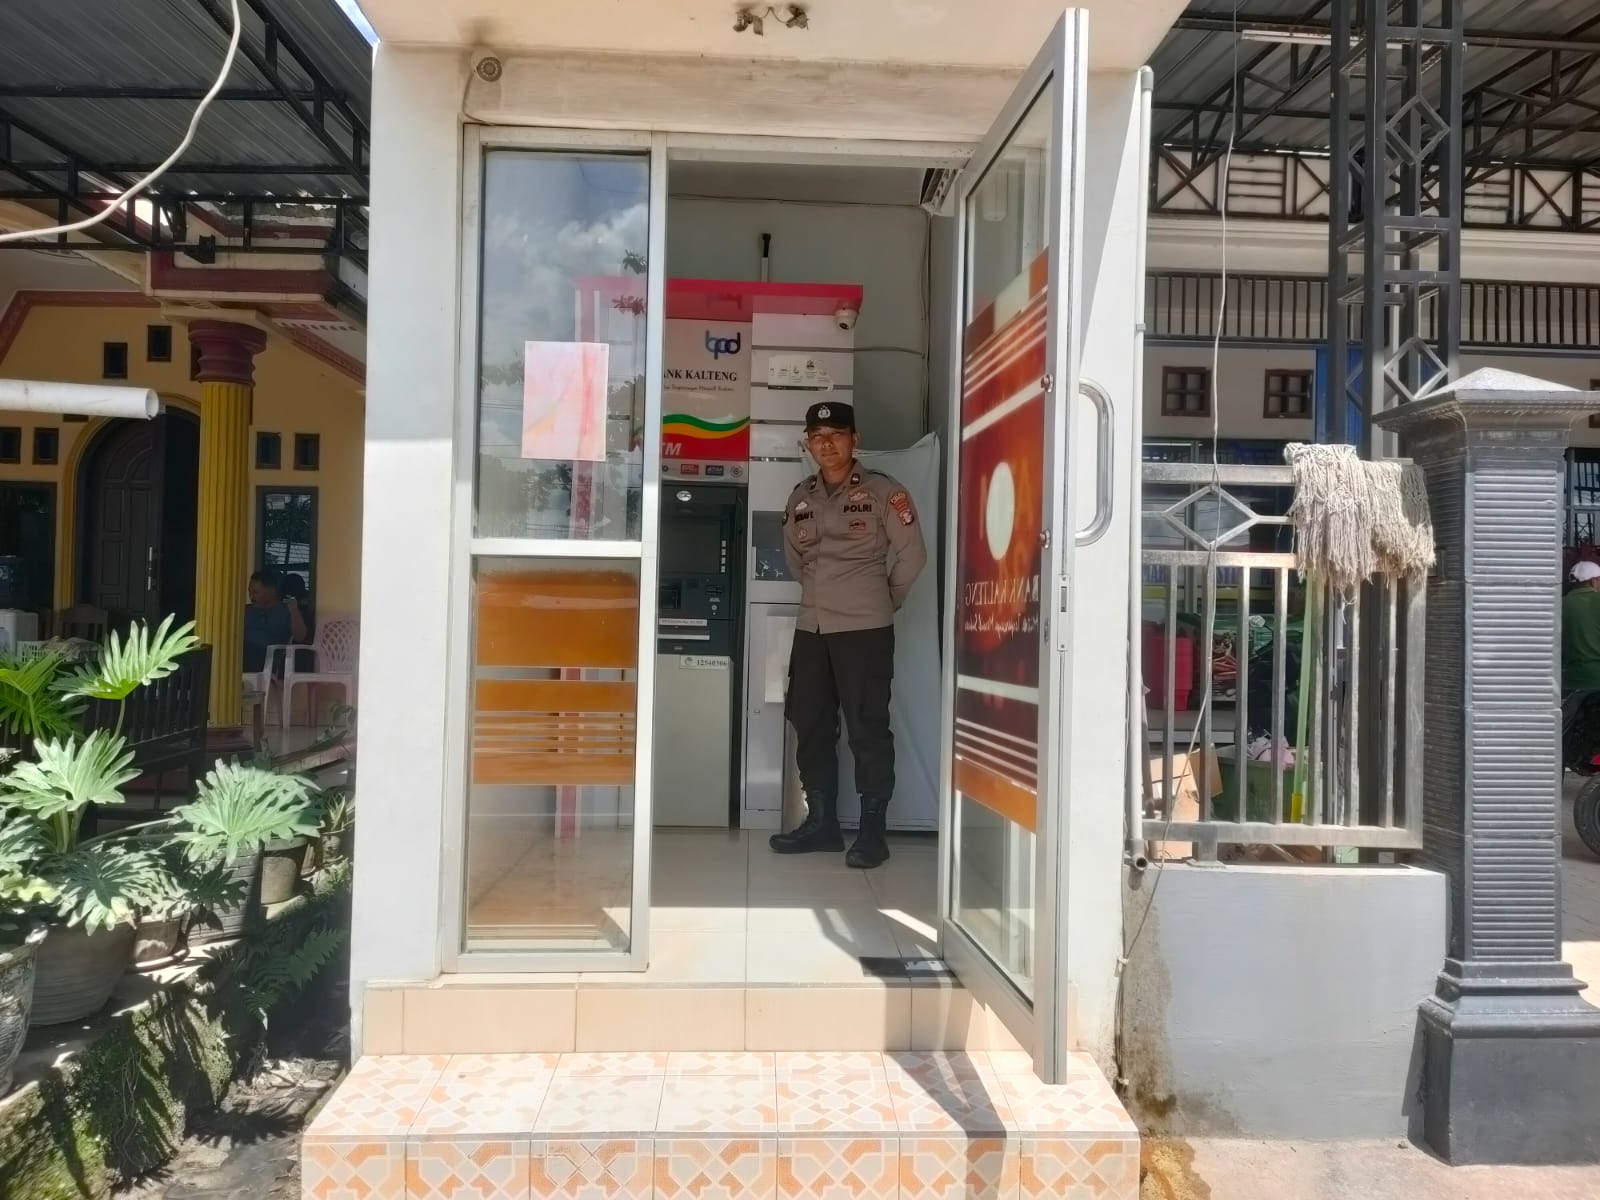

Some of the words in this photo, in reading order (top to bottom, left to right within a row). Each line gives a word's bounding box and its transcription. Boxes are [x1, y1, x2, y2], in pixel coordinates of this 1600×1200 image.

[664, 368, 682, 379] NK
[685, 369, 737, 381] KALTENG
[843, 503, 872, 513] POLRI
